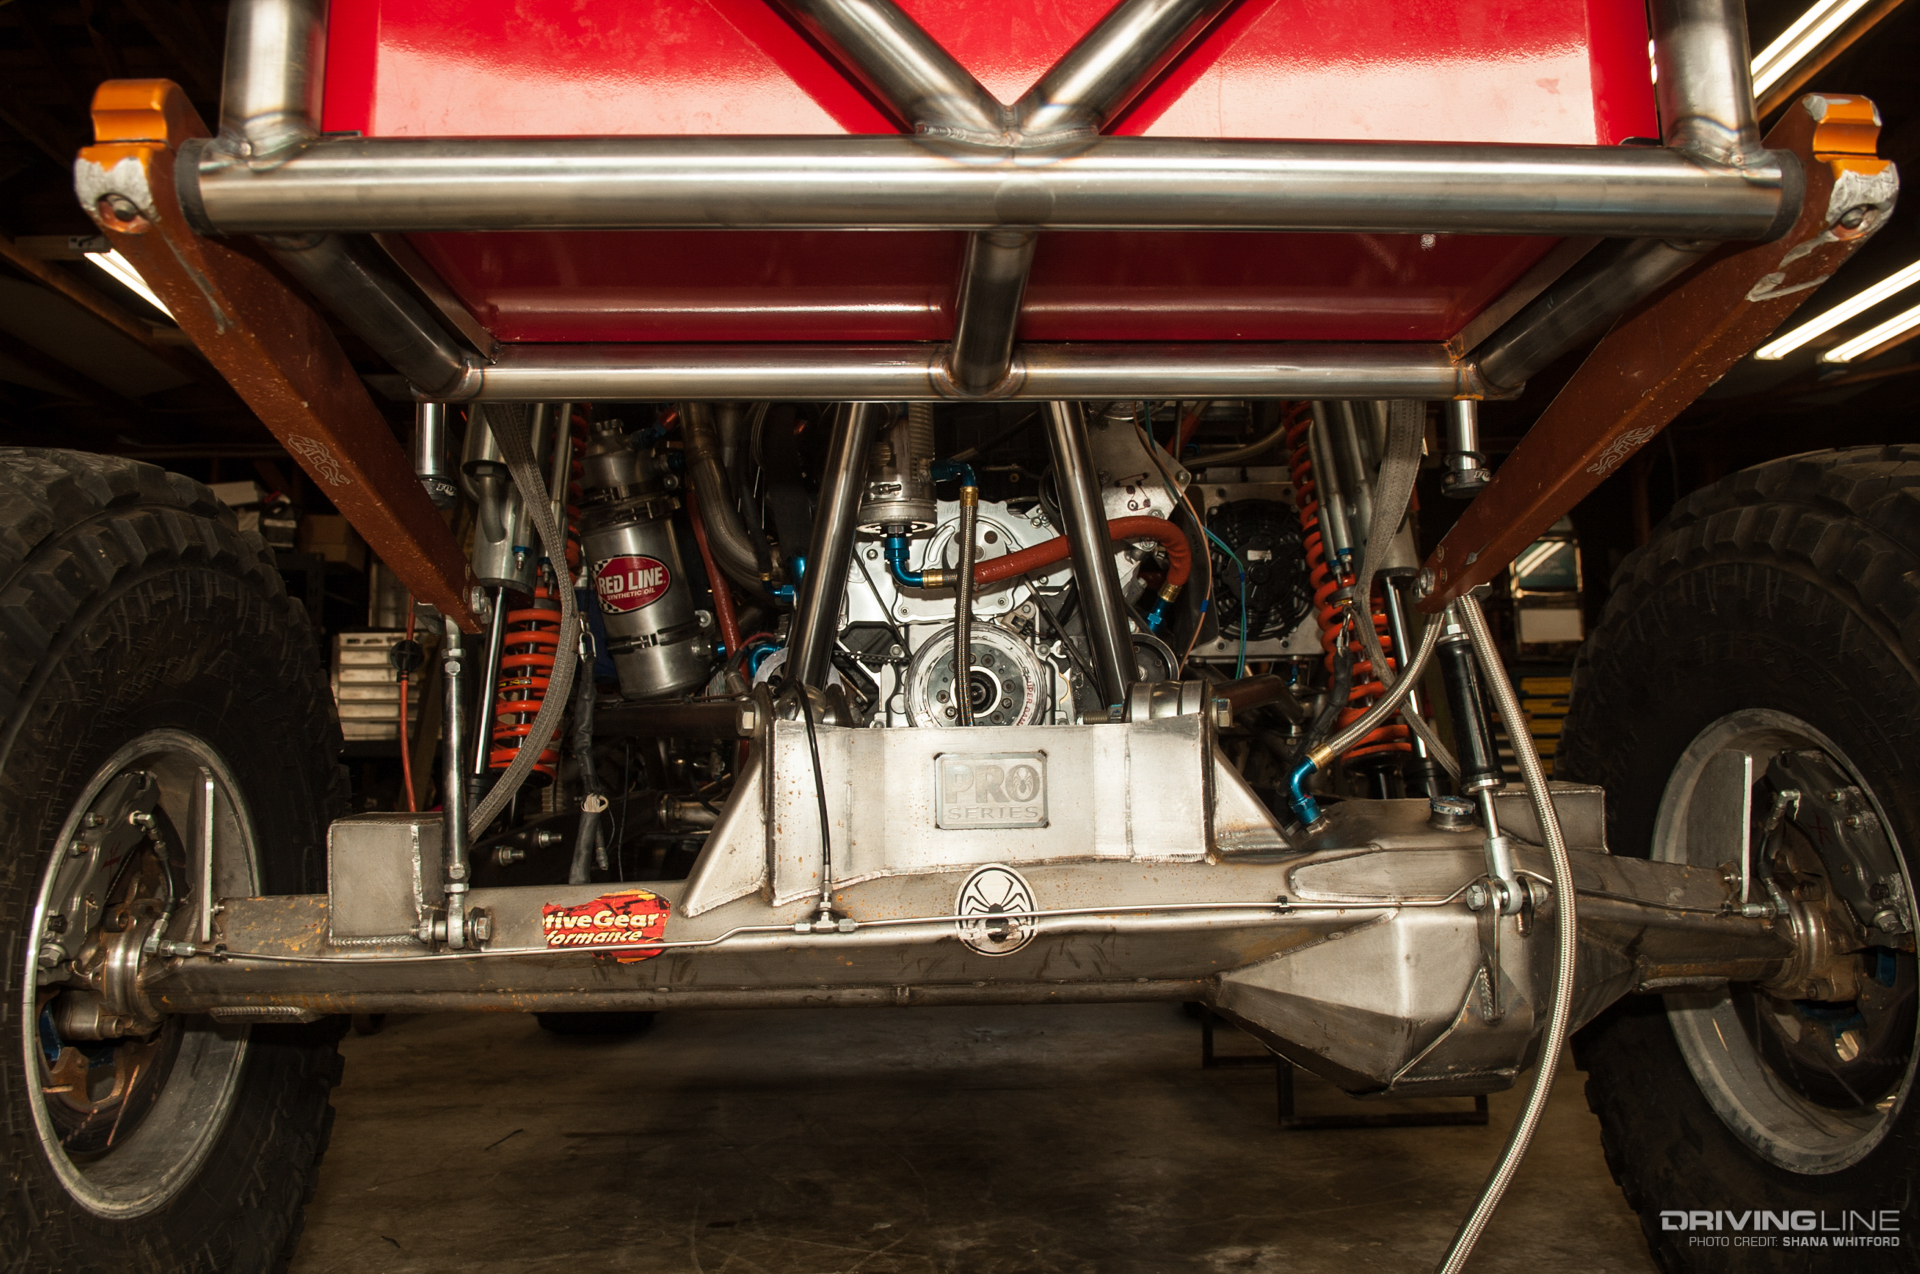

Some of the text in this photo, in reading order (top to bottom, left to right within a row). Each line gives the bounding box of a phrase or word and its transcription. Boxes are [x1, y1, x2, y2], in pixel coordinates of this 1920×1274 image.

[597, 566, 664, 595] RED LINE
[606, 590, 642, 601] SYNTHETIC
[944, 764, 1041, 804] PRO
[947, 806, 1038, 820] SERIES
[542, 910, 660, 930] tiveGear
[543, 929, 643, 945] formance
